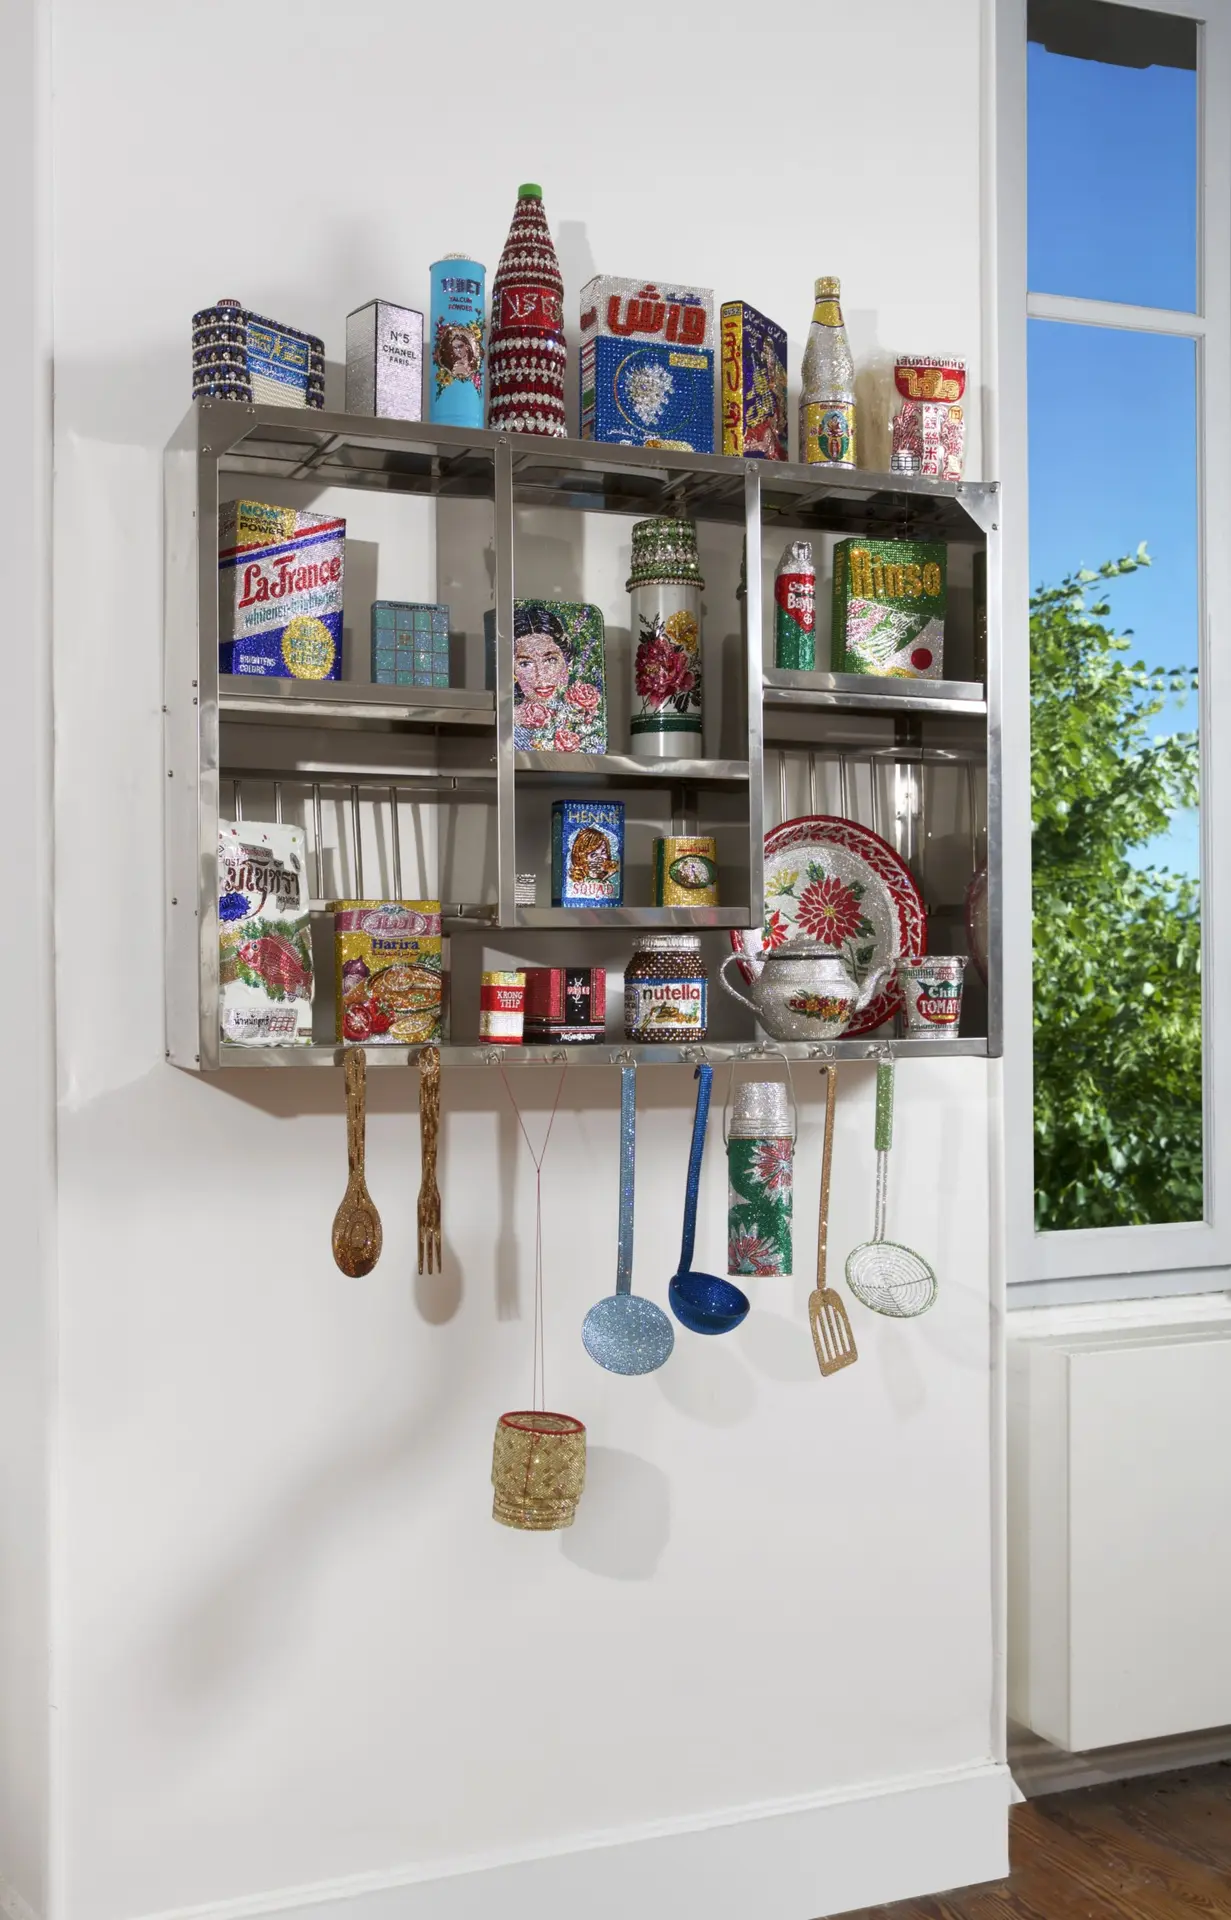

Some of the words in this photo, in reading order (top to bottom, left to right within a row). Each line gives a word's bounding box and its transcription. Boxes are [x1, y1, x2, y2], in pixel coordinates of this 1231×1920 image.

[382, 344, 417, 360] CHANEL
[389, 355, 410, 367] PARIS
[240, 521, 285, 537] POWER
[371, 939, 420, 950] Harira
[496, 990, 524, 1000] KRONG
[642, 984, 701, 1001] nutella
[928, 985, 959, 999] Chili
[500, 999, 521, 1009] THIP
